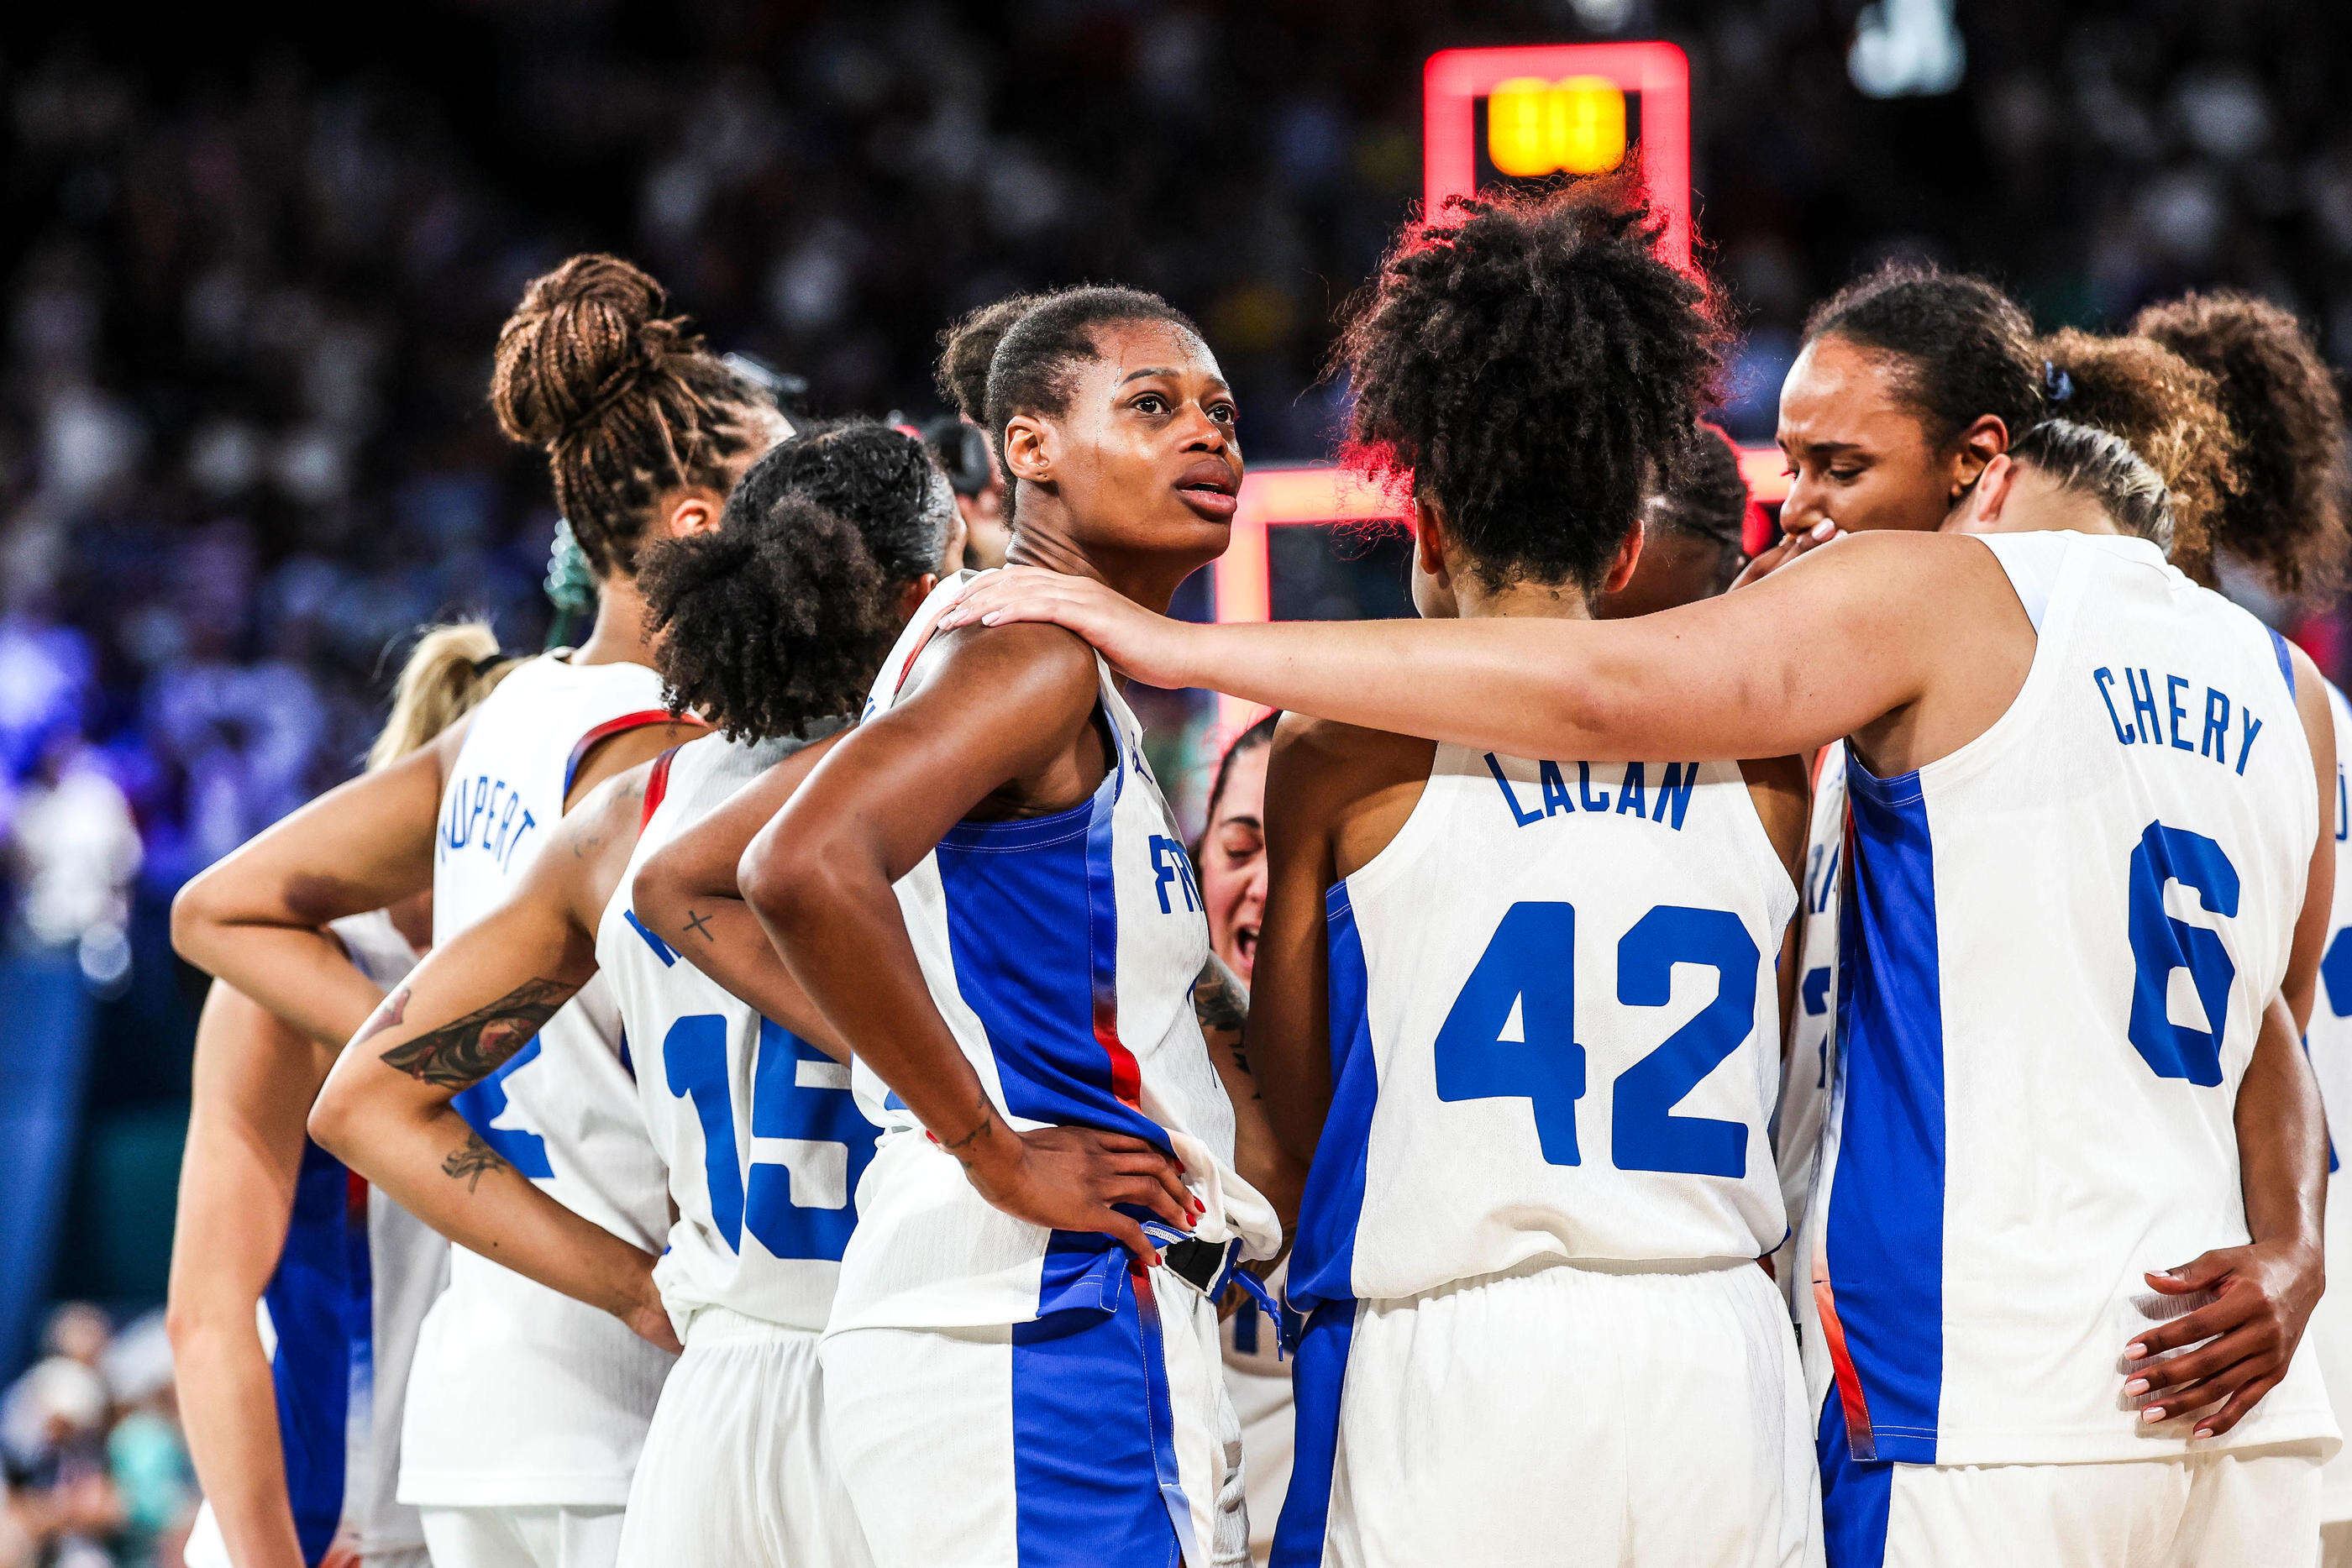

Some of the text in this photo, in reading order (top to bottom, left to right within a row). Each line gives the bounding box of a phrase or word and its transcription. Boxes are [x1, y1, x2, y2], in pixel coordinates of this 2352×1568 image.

[1483, 752, 1699, 831] LACAN
[2093, 667, 2263, 777] CHERY
[1434, 901, 1761, 1179] 42
[2128, 819, 2240, 1088] 6
[663, 1013, 885, 1262] 15
